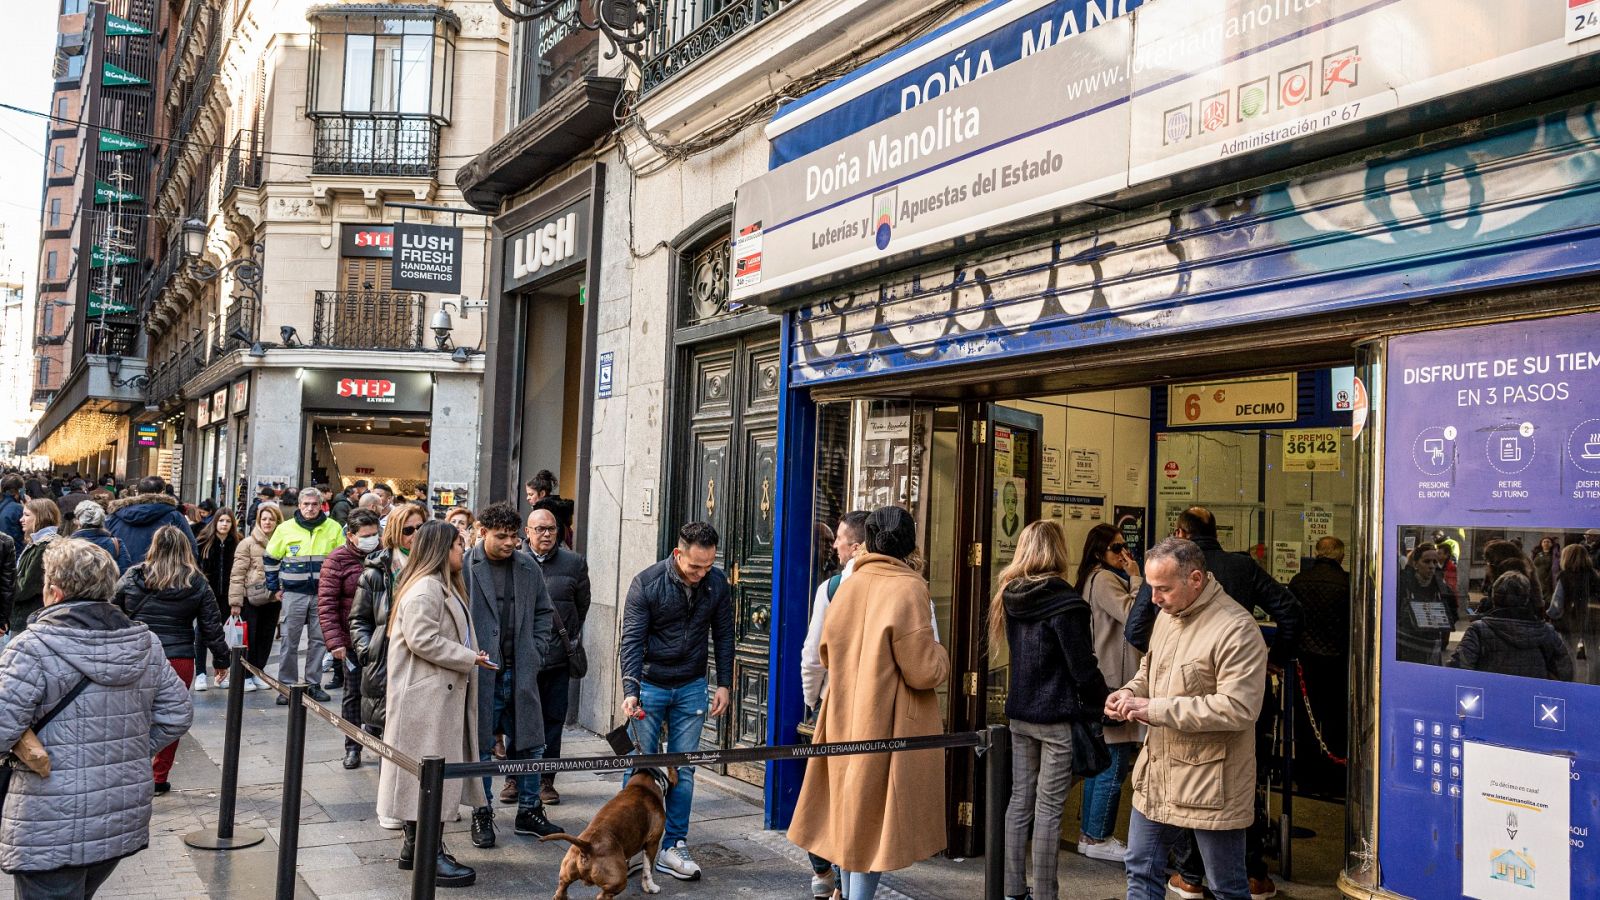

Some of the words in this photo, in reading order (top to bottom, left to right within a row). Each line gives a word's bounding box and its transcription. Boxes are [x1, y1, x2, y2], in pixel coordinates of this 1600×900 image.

[901, 49, 995, 113] DOÑA
[1021, 0, 1141, 60] MAN
[1219, 118, 1317, 157] Administración
[1341, 102, 1361, 121] 67
[806, 152, 860, 201] Doña
[866, 106, 980, 178] Manolita
[812, 220, 858, 250] Loterías
[860, 217, 869, 239] y
[900, 184, 967, 223] Apuestas
[971, 168, 996, 197] del
[1001, 150, 1063, 188] Estado
[402, 233, 454, 251] LUSH
[513, 212, 576, 279] LUSH
[401, 249, 453, 264] FRESH
[401, 262, 453, 273] HANDMADE
[400, 271, 453, 281] COSMETICS
[1403, 361, 1488, 385] DISFRUTE
[1493, 358, 1518, 377] DE
[1523, 355, 1550, 375] SU
[339, 378, 393, 397] STEP
[1457, 388, 1481, 407] EN
[1486, 387, 1497, 405] 3
[1503, 382, 1569, 404] PASOS
[1185, 393, 1201, 421] 6
[1213, 389, 1226, 404] €
[1235, 402, 1285, 416] DECIMO
[1297, 433, 1333, 442] PREMIO
[1287, 440, 1337, 454] 36142
[355, 467, 375, 475] STEP
[1418, 481, 1450, 489] PRESIONE
[1498, 480, 1522, 488] RETIRE
[1427, 489, 1450, 498] BOTÓN
[1492, 490, 1502, 498] SU
[1503, 490, 1529, 498] TURNO
[1573, 491, 1584, 499] SU
[1433, 724, 1441, 735] 2
[791, 739, 907, 757] WWW.LOTERIAMANOLITA.COM
[1415, 740, 1423, 751] 4
[1433, 743, 1441, 755] 5
[498, 759, 634, 773] WWW.LOTERIAMANOLITA.COM
[1415, 759, 1423, 770] 7
[1481, 792, 1549, 809] www.loteriamanolita.com
